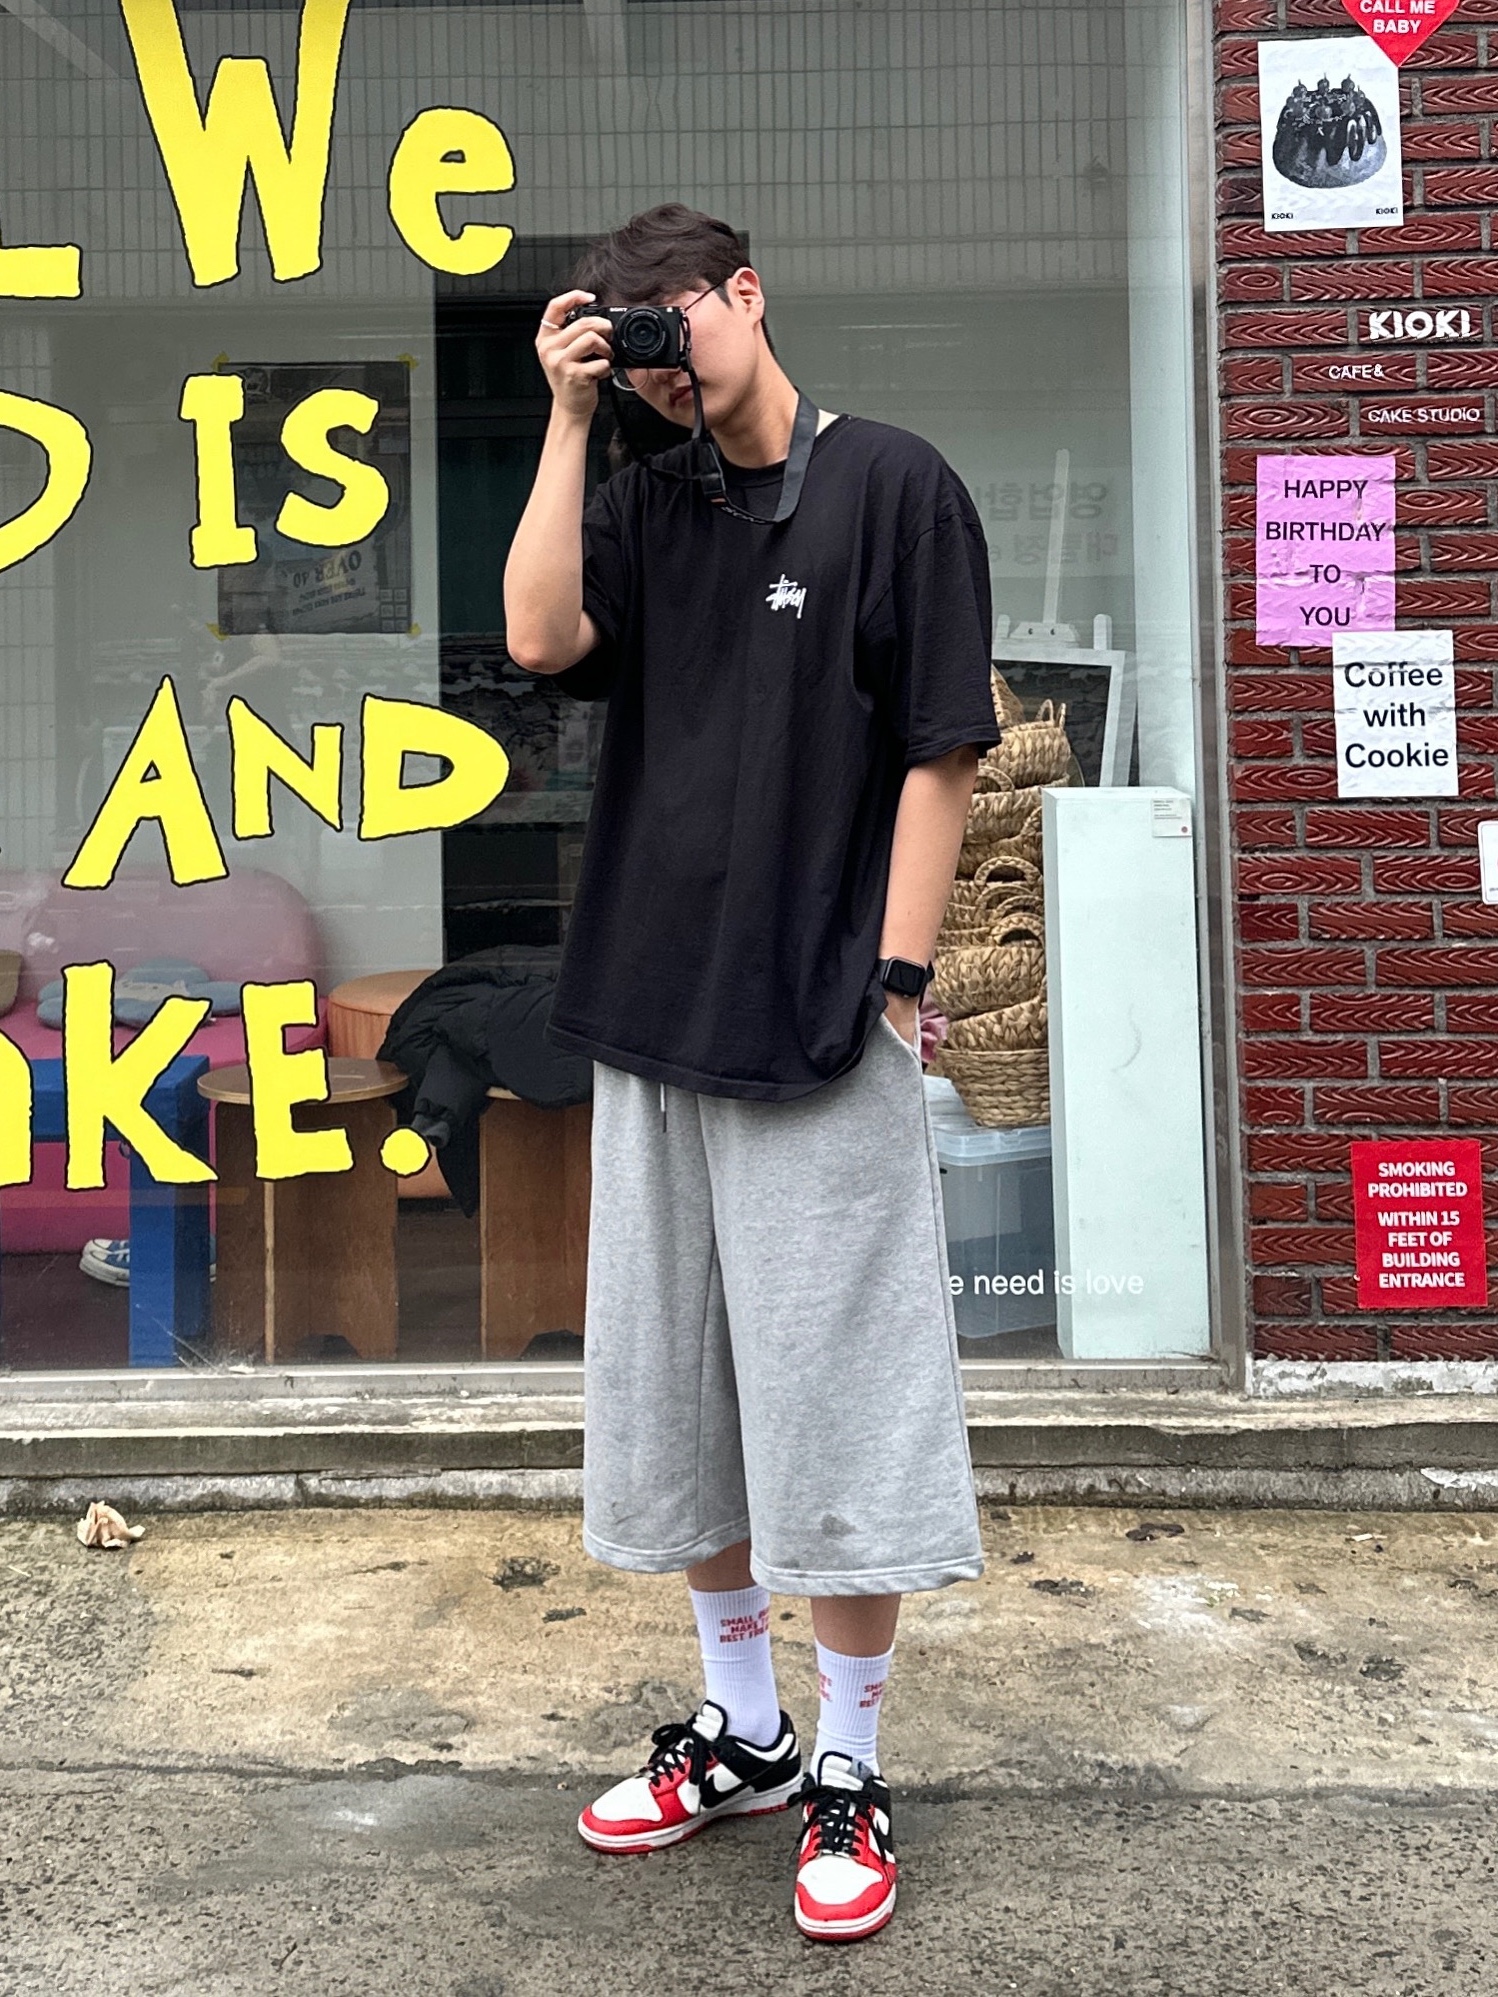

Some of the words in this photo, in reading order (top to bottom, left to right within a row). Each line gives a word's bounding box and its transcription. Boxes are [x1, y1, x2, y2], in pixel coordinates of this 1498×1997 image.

[1360, 0, 1408, 13] CALL
[1410, 0, 1435, 14] ME
[1373, 19, 1422, 33] BABY
[121, 0, 516, 288] We
[1369, 310, 1471, 340] KIOKI
[1368, 410, 1412, 424] CAKE
[1417, 408, 1481, 422] STUDIO
[1283, 479, 1369, 499] HAPPY
[1265, 521, 1387, 541] BIRTHDAY
[1309, 564, 1341, 583] TO
[1300, 606, 1350, 626] YOU
[1344, 661, 1443, 688] Coffee
[1363, 702, 1426, 727] with
[1345, 742, 1449, 768] Cookie
[61, 674, 511, 890] AND
[1378, 1161, 1456, 1177] SMOKING
[1368, 1182, 1468, 1198] PROHIBITED
[1377, 1211, 1439, 1226] WITHIN
[1440, 1211, 1460, 1225] 15
[1388, 1232, 1428, 1247] FEET
[1429, 1231, 1453, 1246] OF
[1382, 1252, 1460, 1268] BUILDING
[974, 1268, 1044, 1295] need
[1054, 1269, 1076, 1295] is
[1086, 1269, 1144, 1295] love
[1379, 1272, 1466, 1288] ENTRANCE
